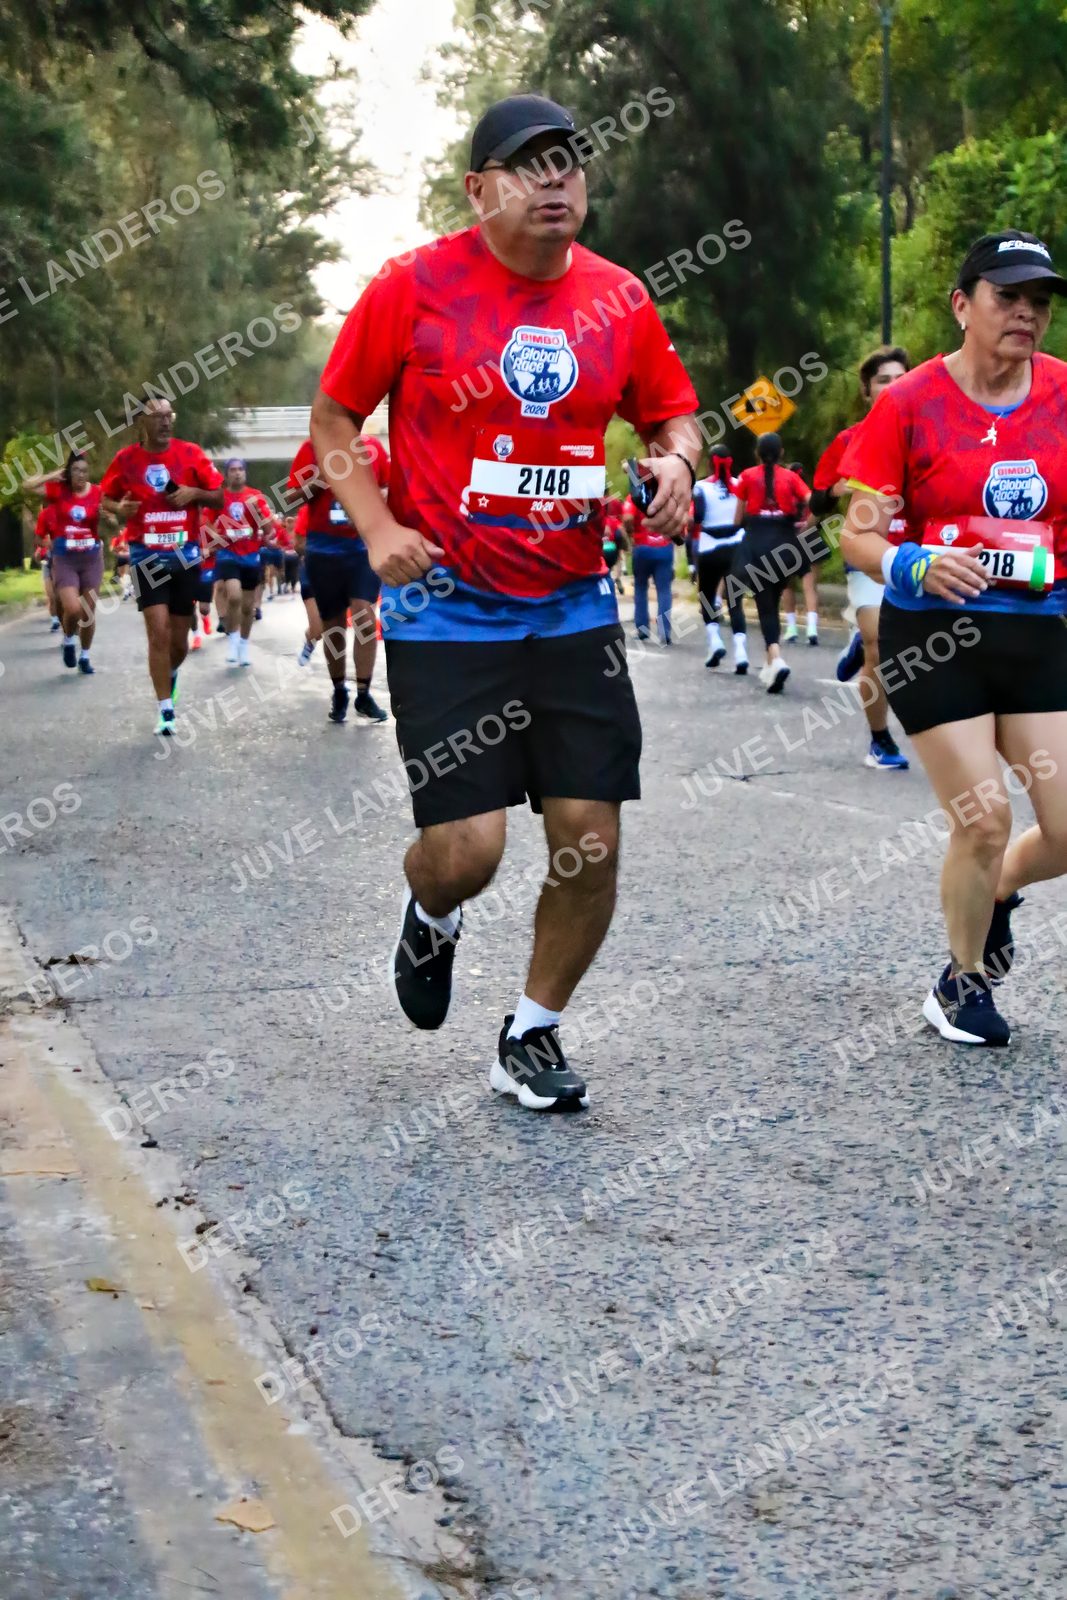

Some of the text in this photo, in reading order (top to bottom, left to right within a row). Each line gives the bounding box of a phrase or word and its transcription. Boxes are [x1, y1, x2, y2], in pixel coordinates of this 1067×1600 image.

[520, 333, 560, 345] BIMBO
[521, 347, 560, 363] Global
[513, 358, 544, 373] Race
[523, 404, 546, 415] 2026
[997, 466, 1031, 476] BIMBO
[518, 467, 570, 496] 2148
[1000, 479, 1031, 490] Global
[993, 490, 1019, 501] Race
[144, 510, 187, 522] SANTIAGO
